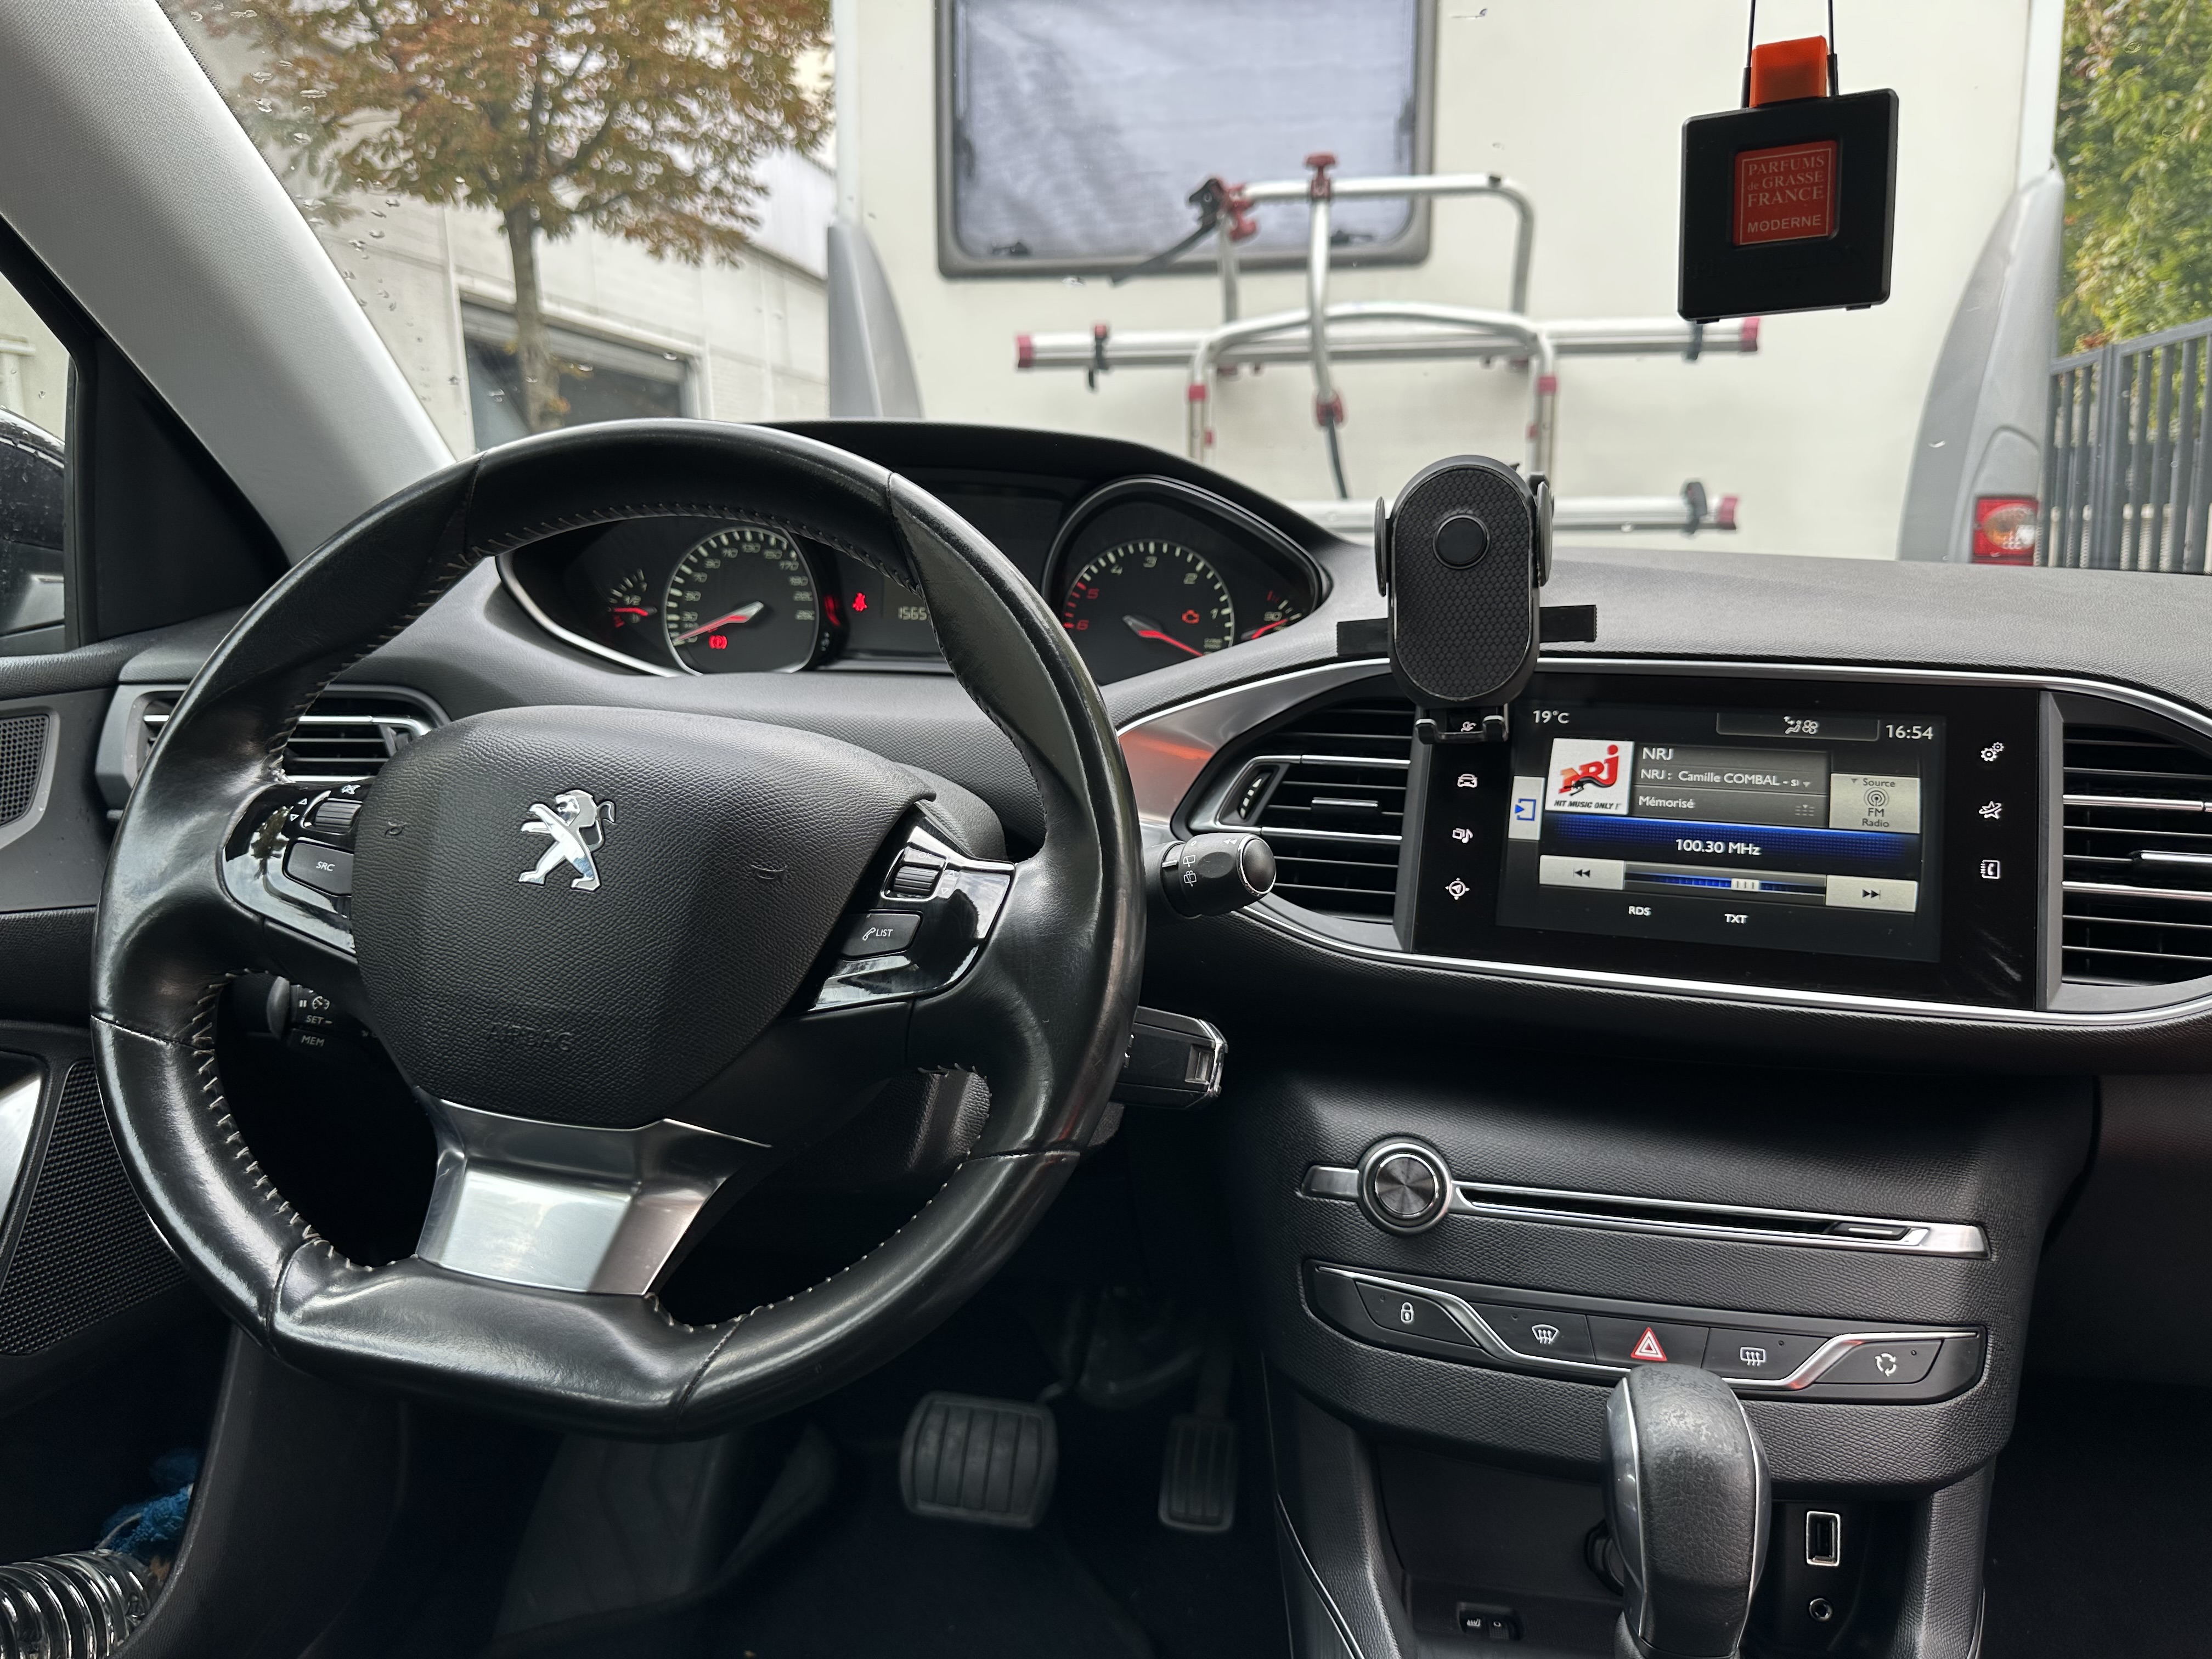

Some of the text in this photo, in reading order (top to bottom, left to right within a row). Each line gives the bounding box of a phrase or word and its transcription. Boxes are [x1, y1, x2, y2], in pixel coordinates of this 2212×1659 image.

[1748, 155, 1825, 176] PARFUMS
[1747, 171, 1824, 191] de GRASSE
[1748, 185, 1824, 207] FRANCE
[1747, 215, 1821, 233] MODERNE
[1143, 556, 1158, 568] 3
[1110, 564, 1123, 575] 4
[1183, 573, 1198, 584] 2
[1087, 588, 1099, 599] 5
[1210, 608, 1218, 620] 1
[1533, 710, 1570, 724] 19°C
[1886, 724, 1933, 740] 16:54
[1643, 747, 1673, 760] NRJ
[1678, 771, 1721, 783] Camille
[1724, 773, 1780, 786] COMBAL
[1863, 778, 1895, 787] Source
[1639, 795, 1695, 809] Mémorisé
[1867, 808, 1884, 817] FM
[1862, 819, 1889, 827] Radio
[1675, 839, 1762, 855] 100.30 MHz
[315, 861, 336, 872] SRC
[1628, 906, 1652, 916] RDS
[1725, 913, 1748, 924] TXT
[876, 929, 893, 937] LIST
[306, 1015, 325, 1024] SET
[301, 1035, 325, 1047] MEM
